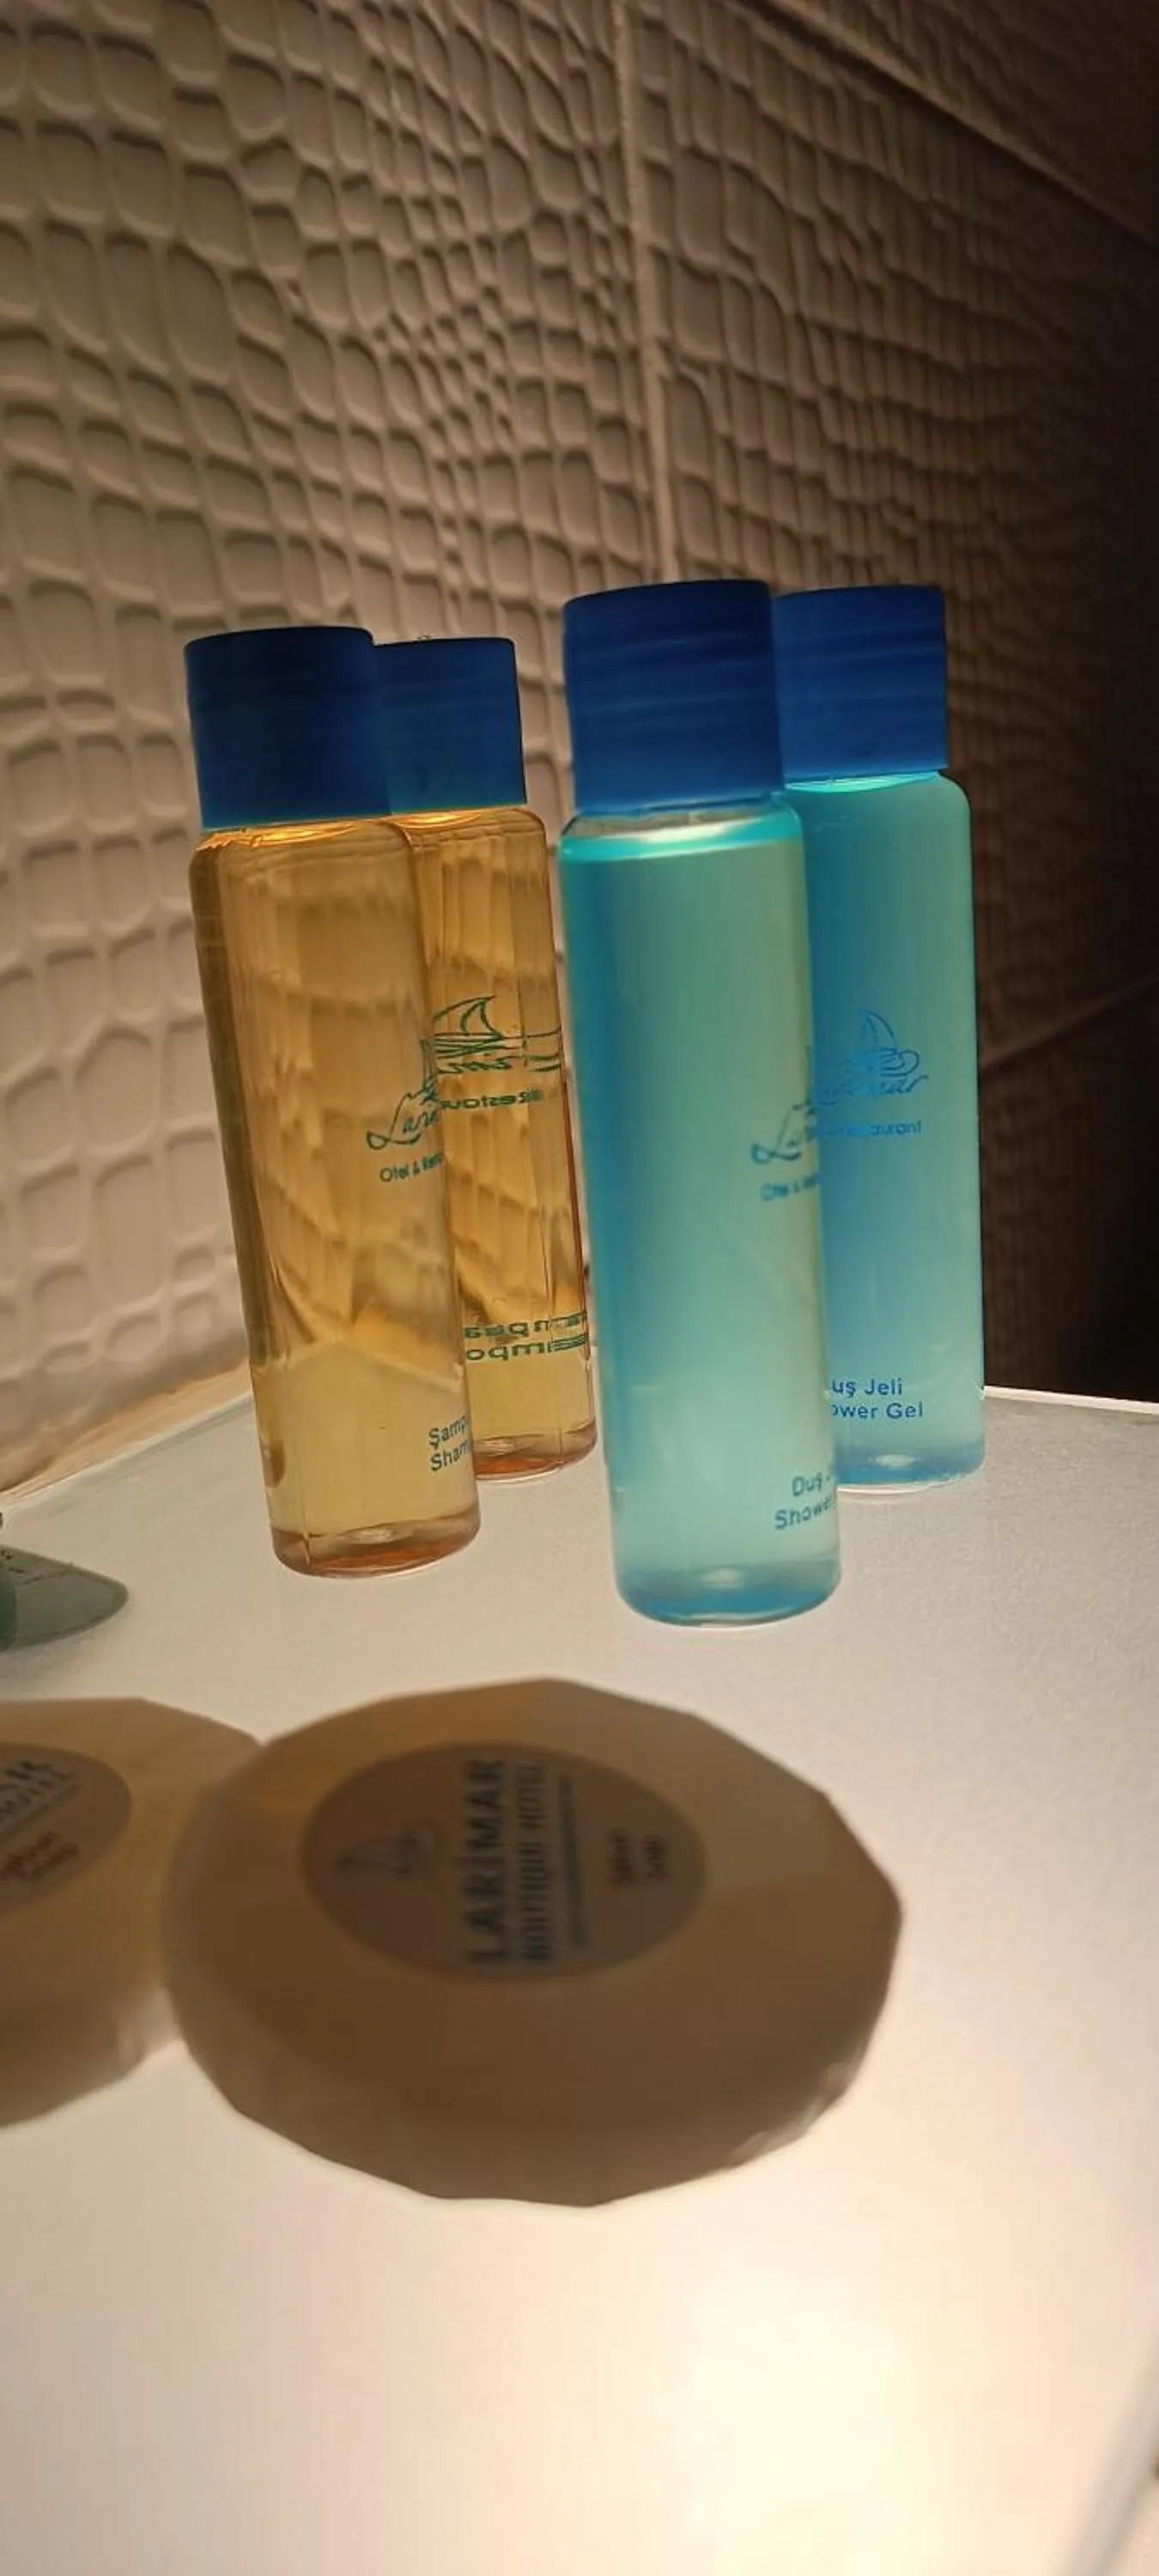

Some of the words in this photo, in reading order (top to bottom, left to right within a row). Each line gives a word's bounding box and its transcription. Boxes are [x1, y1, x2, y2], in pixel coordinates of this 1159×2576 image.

[831, 1379, 856, 1398] uş
[865, 1376, 902, 1396] Jeli
[830, 1403, 877, 1419] ower
[886, 1400, 923, 1419] Gel
[430, 1441, 469, 1471] Sham
